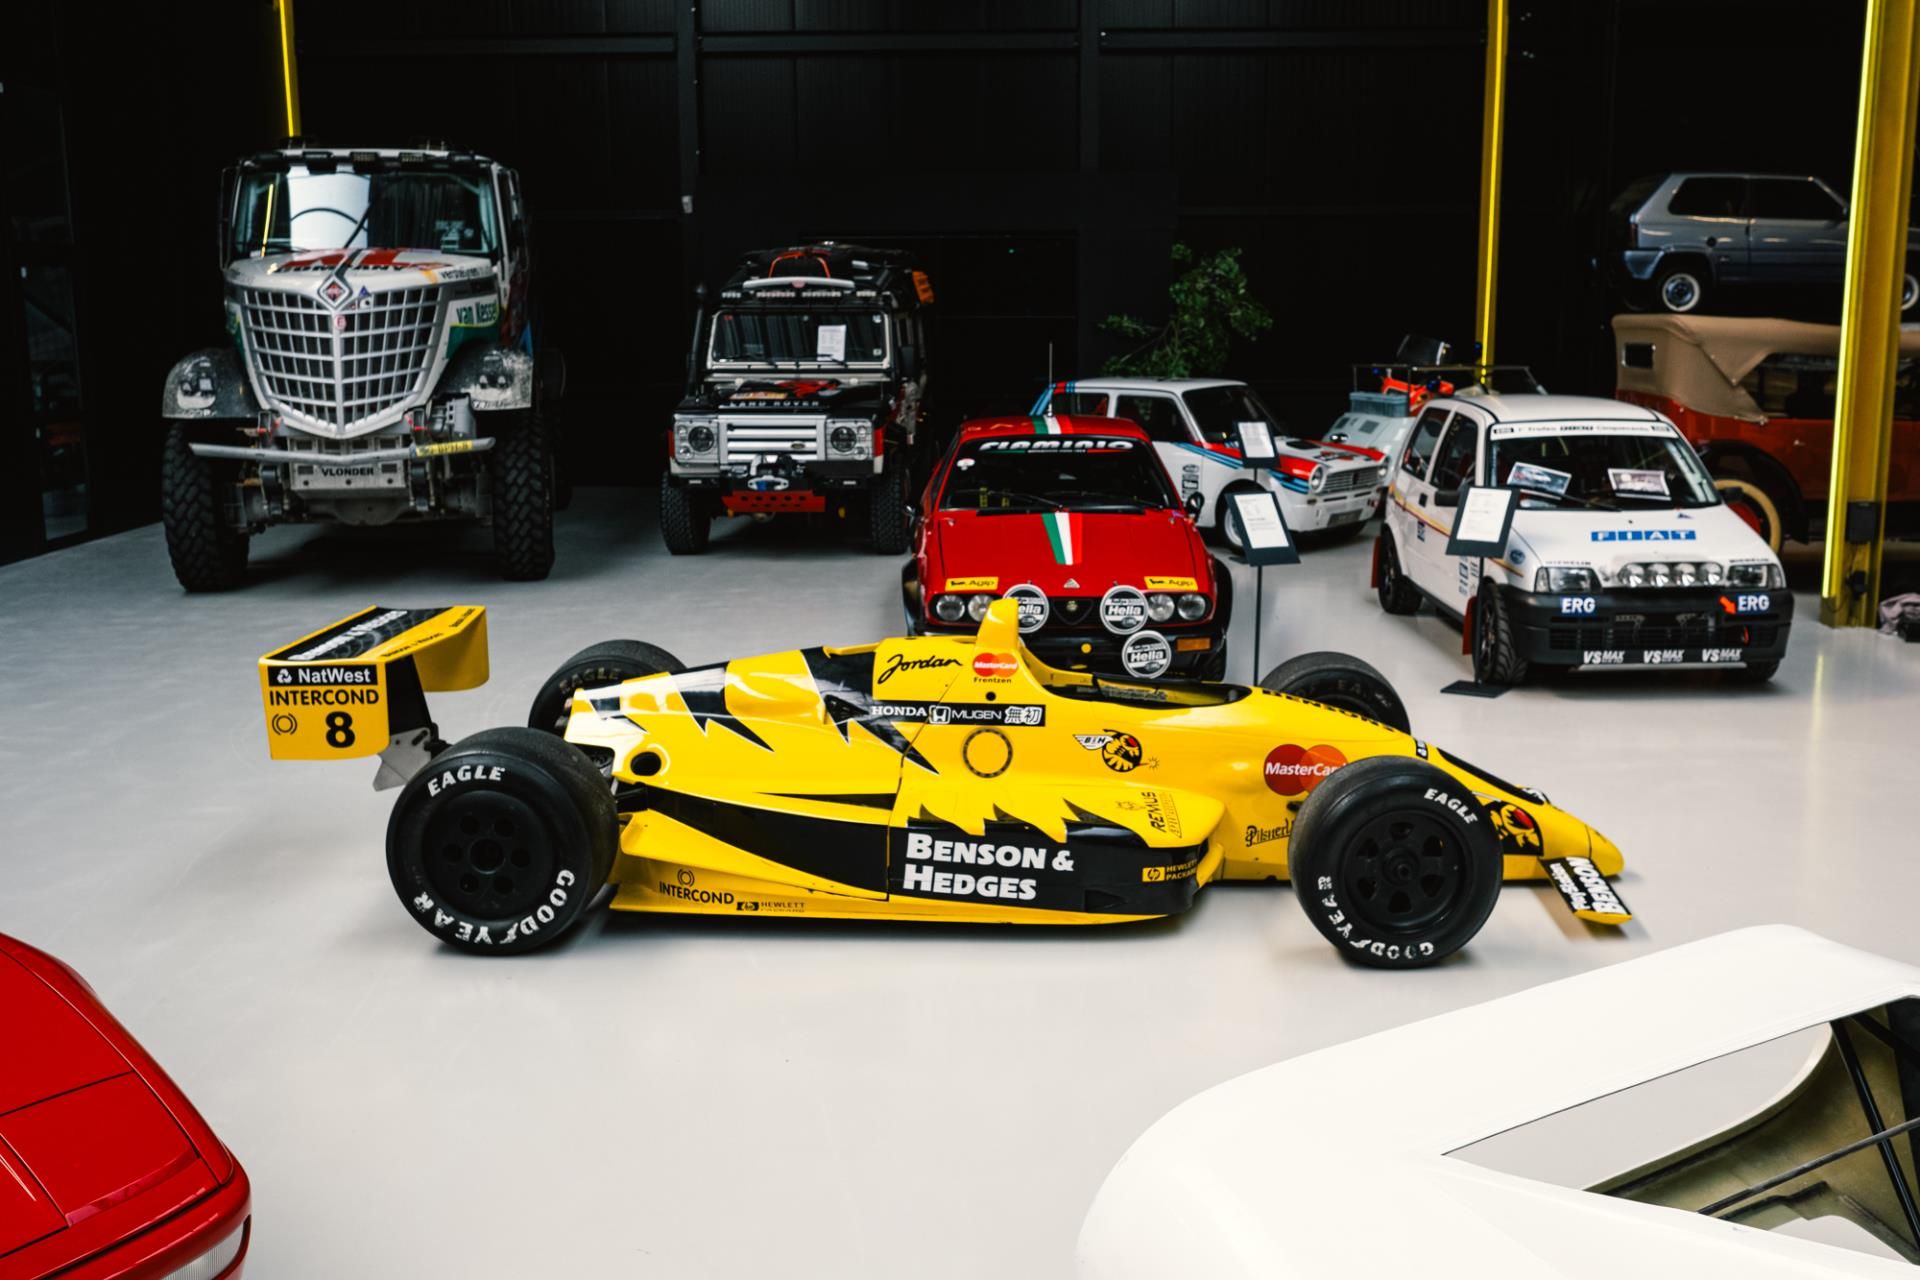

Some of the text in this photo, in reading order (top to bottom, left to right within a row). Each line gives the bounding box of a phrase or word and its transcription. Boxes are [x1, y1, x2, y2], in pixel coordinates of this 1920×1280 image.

[321, 466, 374, 477] VLONDER
[1591, 530, 1697, 542] FIAT
[1018, 603, 1042, 614] ella
[1108, 605, 1142, 616] Hella
[1561, 597, 1596, 613] ERG
[1737, 595, 1770, 612] ERG
[1130, 650, 1164, 663] Hella
[1583, 651, 1602, 664] VS
[1643, 650, 1662, 664] VS
[1702, 649, 1720, 662] VS
[878, 654, 963, 684] Jordan
[974, 661, 1018, 670] MasterCard
[298, 668, 371, 684] NatWest
[270, 689, 379, 707] INTERCOND
[870, 706, 927, 717] HONDA
[952, 710, 1002, 719] MUGEN
[325, 711, 356, 748] 8
[1265, 762, 1346, 777] MasterCar
[427, 764, 505, 797] EAGLE
[1141, 792, 1167, 833] REMUS
[1424, 788, 1479, 824] EAGLE
[906, 832, 1075, 871] BENSON &
[902, 863, 1037, 900] HEDGES
[1167, 868, 1197, 881] PACKAR
[659, 881, 734, 905] INTERCOND
